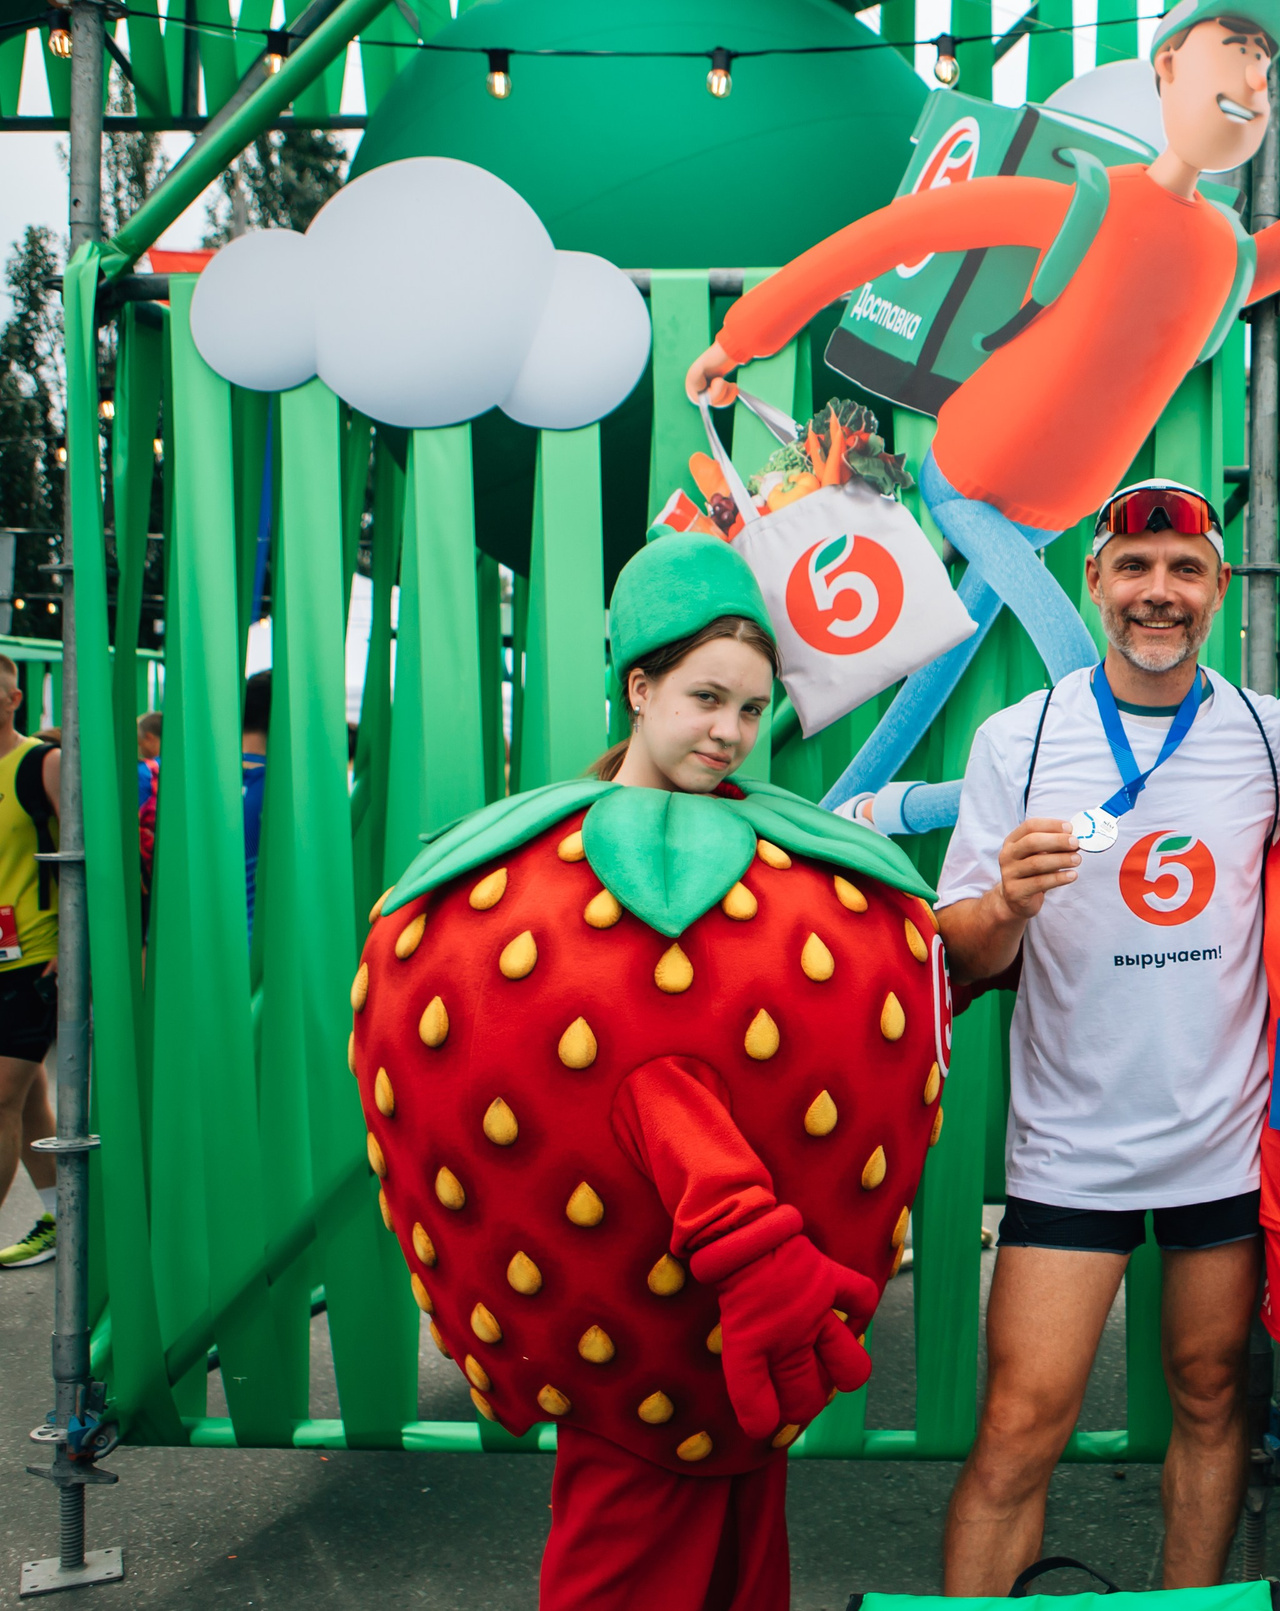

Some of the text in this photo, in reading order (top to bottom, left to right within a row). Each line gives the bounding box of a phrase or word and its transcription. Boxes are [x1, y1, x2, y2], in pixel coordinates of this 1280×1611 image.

[851, 281, 923, 341] Доставка
[808, 533, 880, 639] 5
[1141, 830, 1202, 913] 5
[1113, 945, 1223, 969] выручает!
